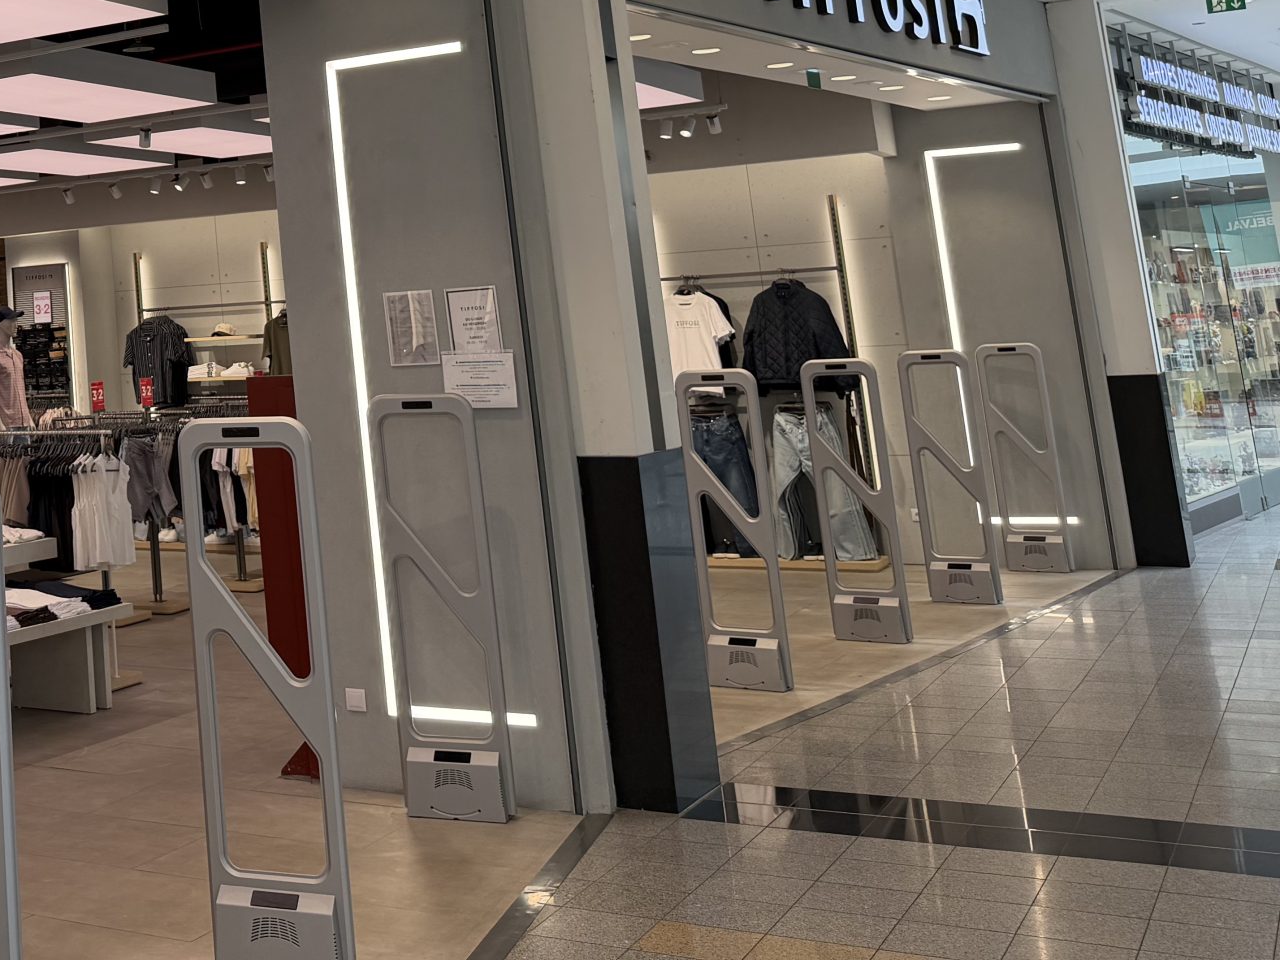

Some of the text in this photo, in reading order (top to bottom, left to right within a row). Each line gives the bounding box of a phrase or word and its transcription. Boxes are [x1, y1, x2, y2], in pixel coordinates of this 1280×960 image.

[1140, 55, 1178, 90] BANDES
[1222, 81, 1255, 112] MANGAS
[1136, 89, 1203, 135] SÉRIGRAPHIES
[1204, 113, 1232, 144] OBJETS
